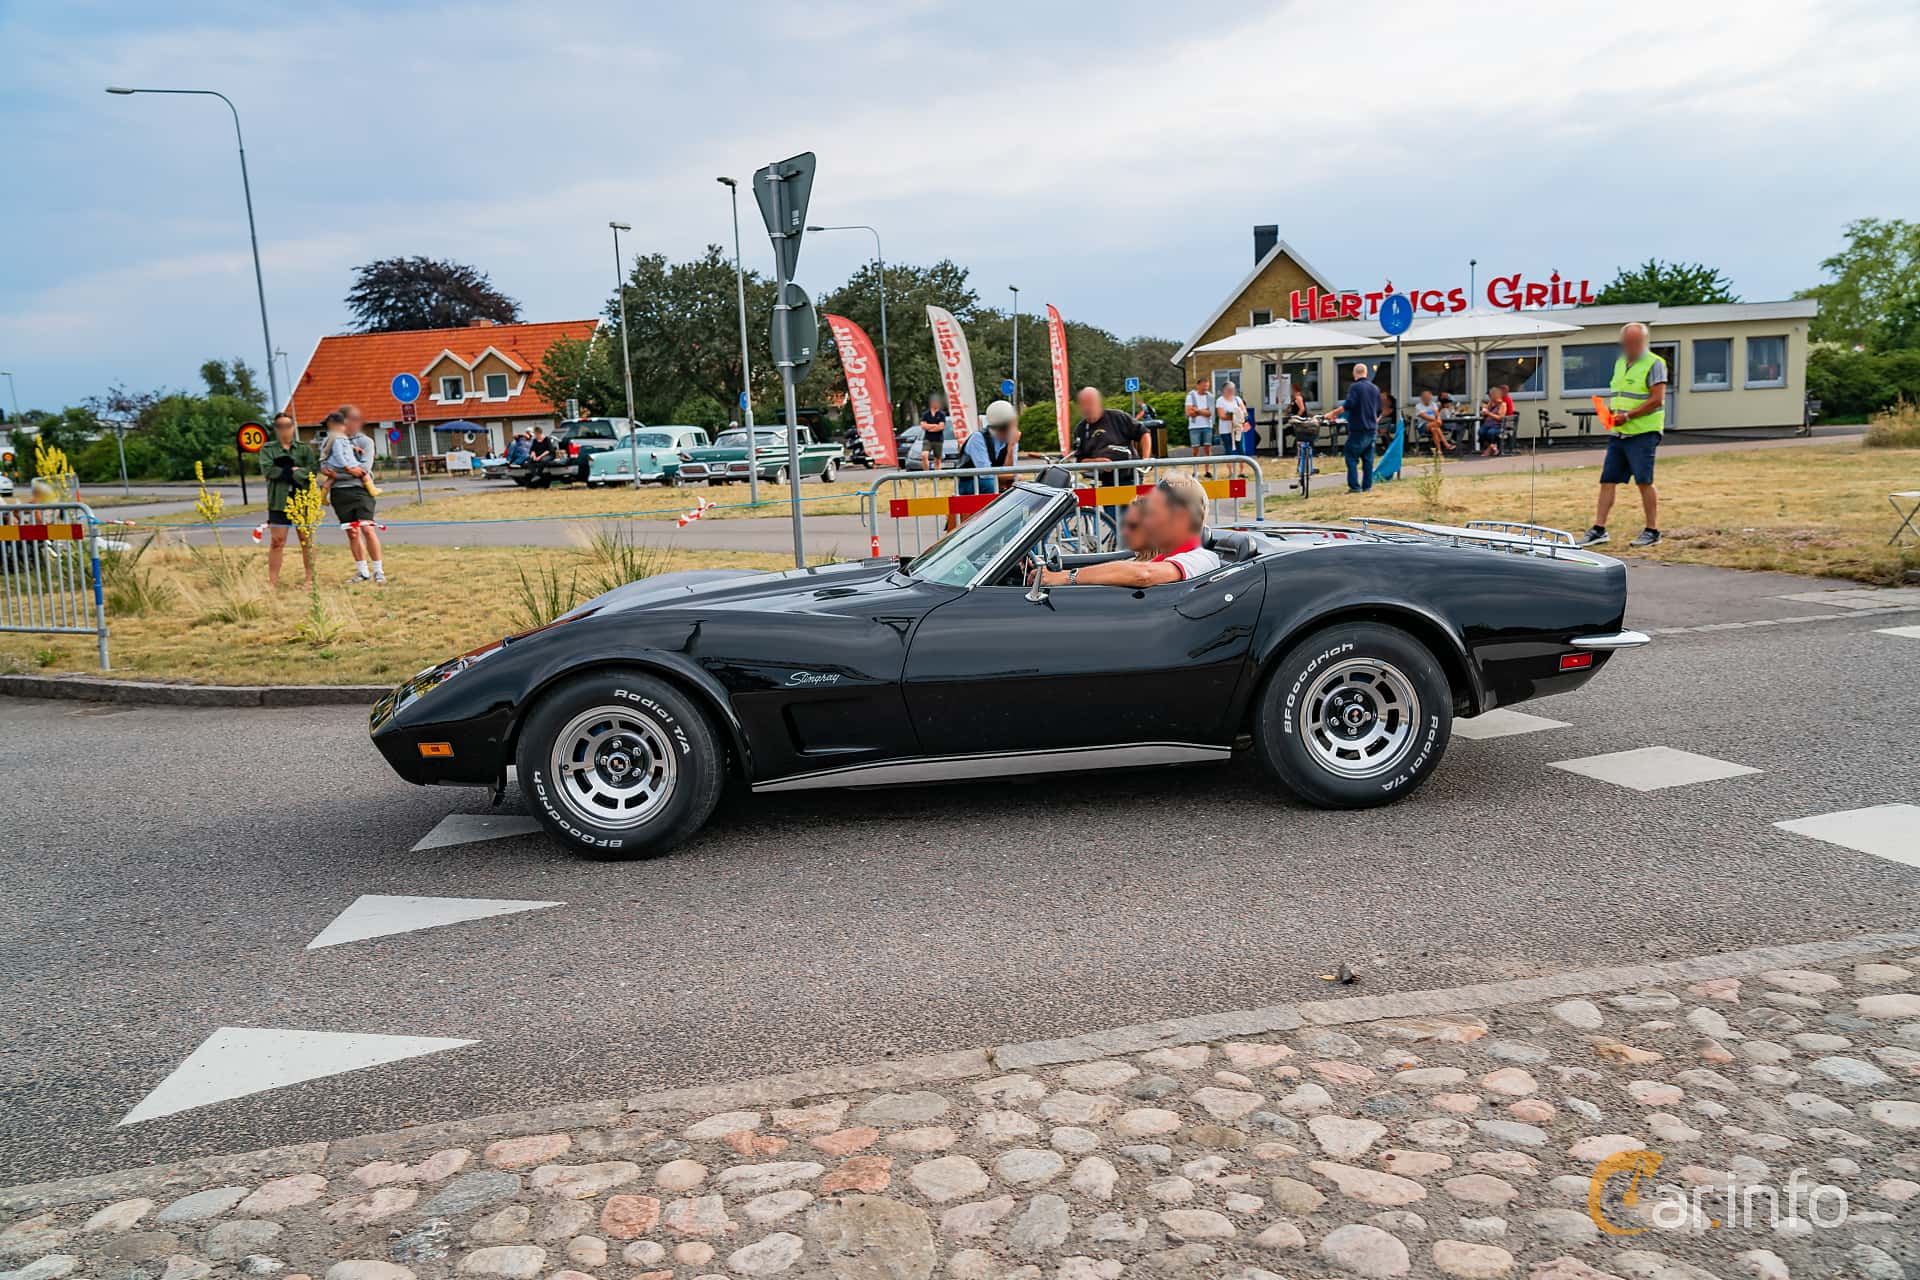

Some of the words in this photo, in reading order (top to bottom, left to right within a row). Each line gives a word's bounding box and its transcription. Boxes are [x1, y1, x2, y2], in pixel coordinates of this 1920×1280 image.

[244, 431, 262, 445] 30
[785, 672, 840, 687] Stingray
[1283, 643, 1354, 734] BFGoodrich
[614, 689, 673, 724] Radial
[672, 725, 690, 755] T/A
[1407, 715, 1439, 776] Radial
[532, 770, 622, 849] BFGoodrich
